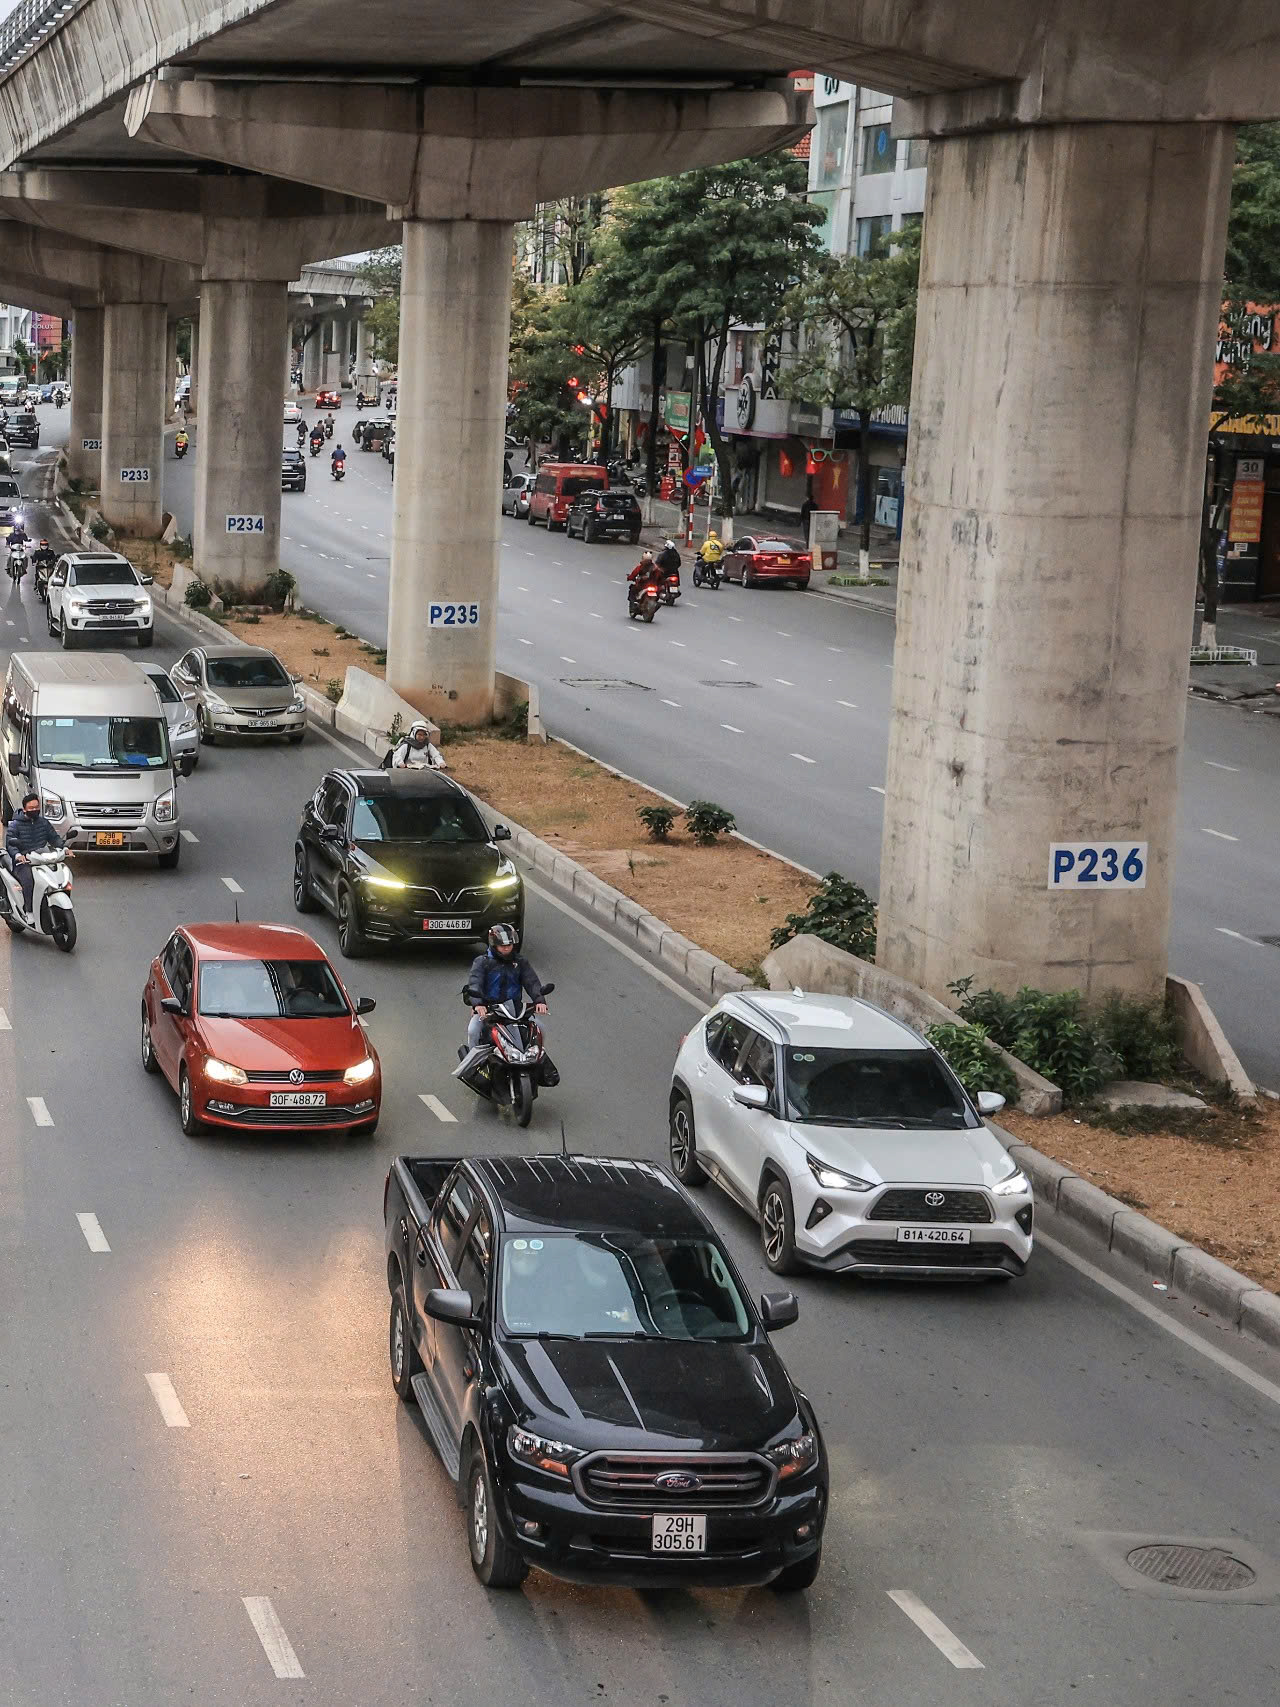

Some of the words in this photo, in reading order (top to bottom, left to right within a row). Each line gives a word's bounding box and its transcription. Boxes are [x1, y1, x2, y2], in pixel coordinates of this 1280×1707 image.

[121, 470, 149, 481] P233
[227, 517, 264, 531] P234
[430, 605, 478, 625] P235
[1053, 847, 1144, 884] P236
[271, 1094, 325, 1105] 30F-488.72
[903, 1230, 965, 1242] 81A-420.64
[665, 1516, 694, 1533] 29H
[653, 1533, 703, 1550] 305.61
